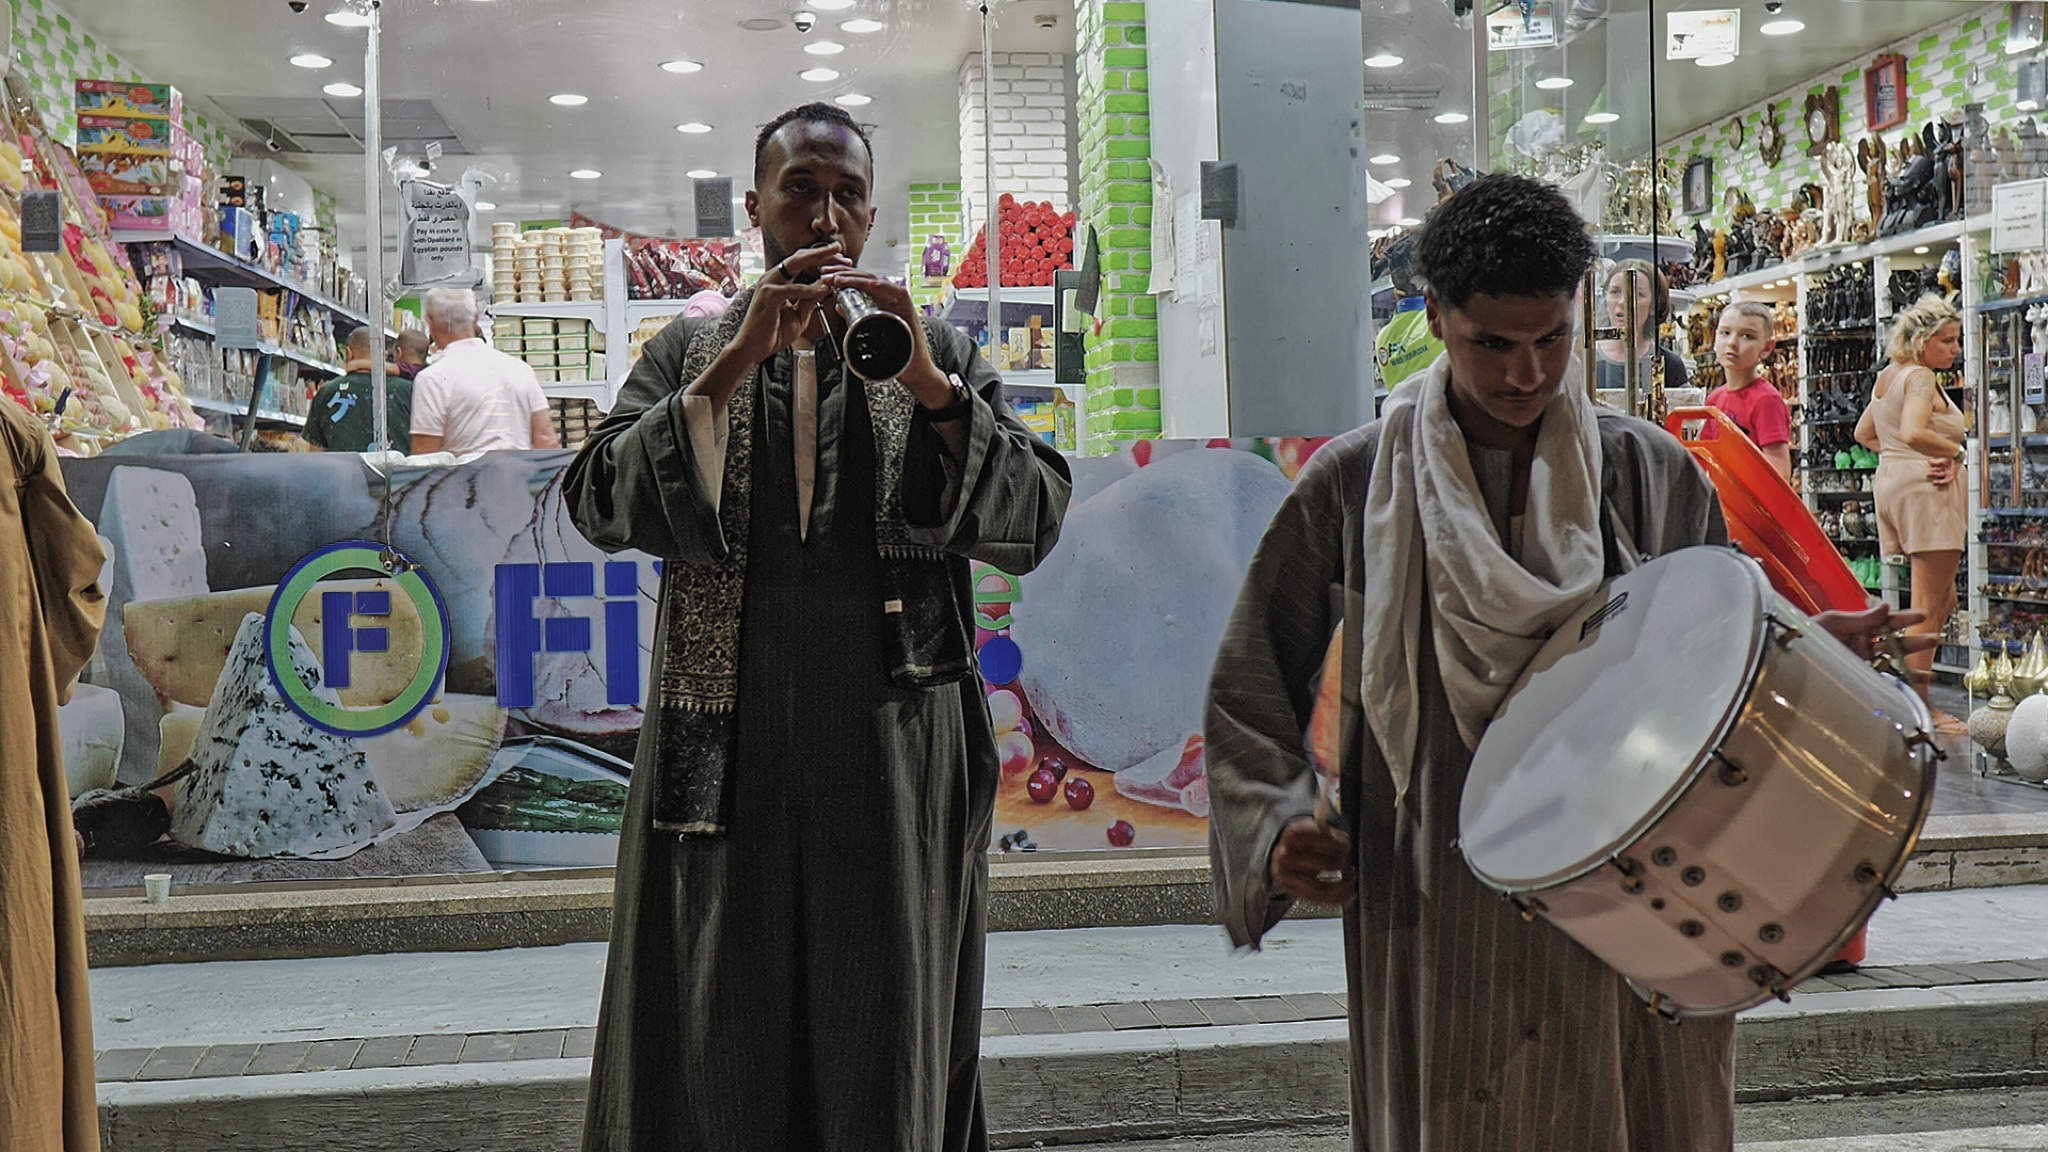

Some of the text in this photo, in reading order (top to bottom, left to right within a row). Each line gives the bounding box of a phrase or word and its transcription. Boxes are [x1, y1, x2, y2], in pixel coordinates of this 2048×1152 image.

[413, 245, 463, 254] Egyptian pounds
[322, 590, 392, 688] F
[494, 561, 662, 709] Fi
